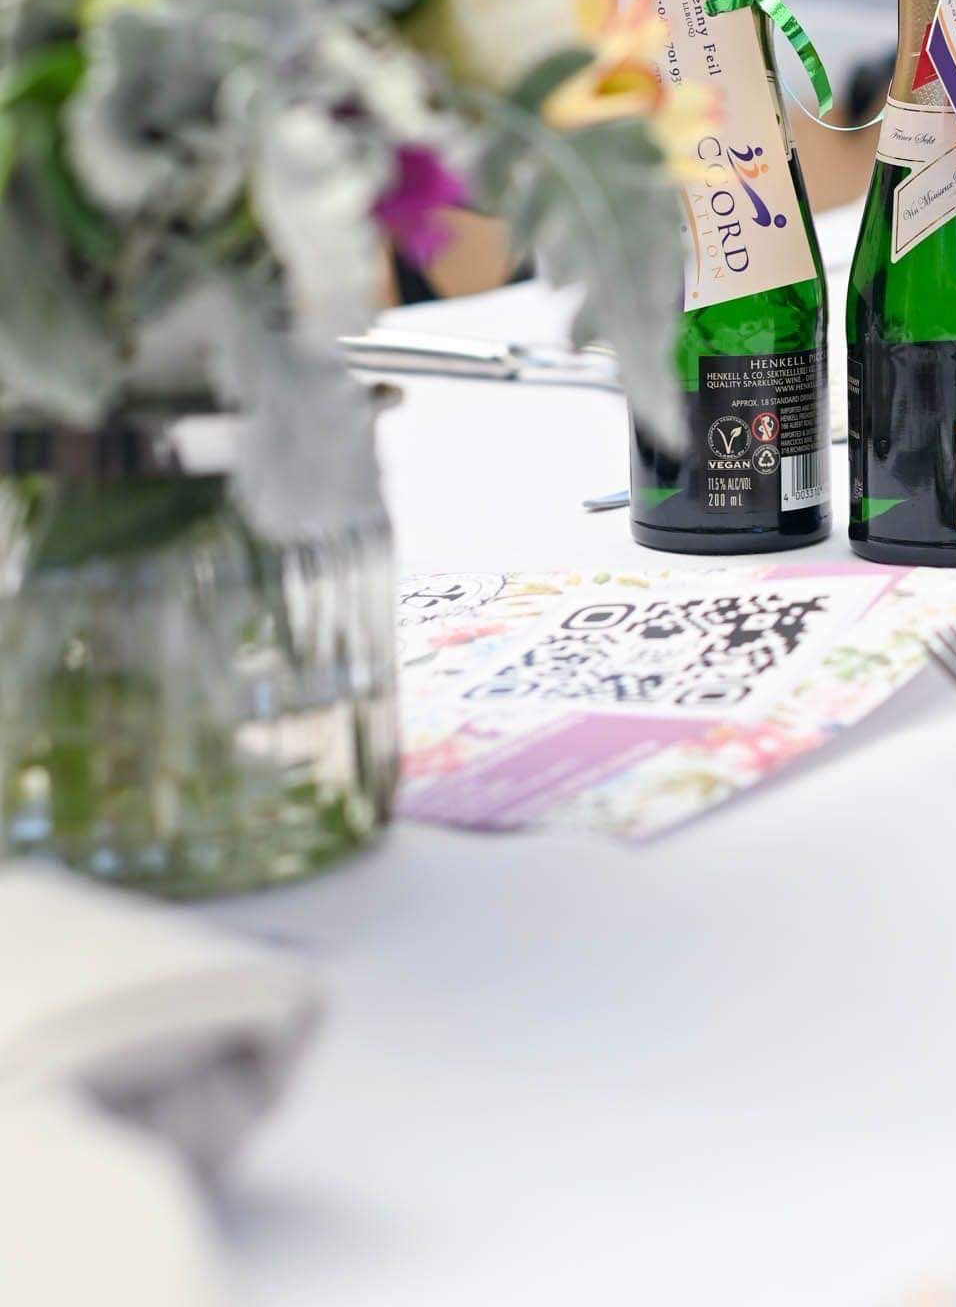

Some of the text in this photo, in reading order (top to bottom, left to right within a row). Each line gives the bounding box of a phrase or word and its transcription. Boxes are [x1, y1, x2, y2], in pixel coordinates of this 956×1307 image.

[664, 42, 678, 63] 701
[703, 43, 722, 76] Feil
[669, 66, 682, 86] 93
[698, 136, 750, 273] CCORD
[903, 204, 919, 221] Vin
[750, 356, 805, 370] HENKELL
[706, 372, 741, 381] HENKELL
[743, 371, 750, 380] &
[706, 380, 741, 389] QUALITY
[743, 378, 784, 388] SPARKLING
[731, 399, 759, 407] APPROX.
[770, 396, 799, 406] STANDARD
[708, 461, 751, 469] VEGAN
[727, 477, 752, 491] ALC/VOL
[708, 493, 743, 507] 200 mL
